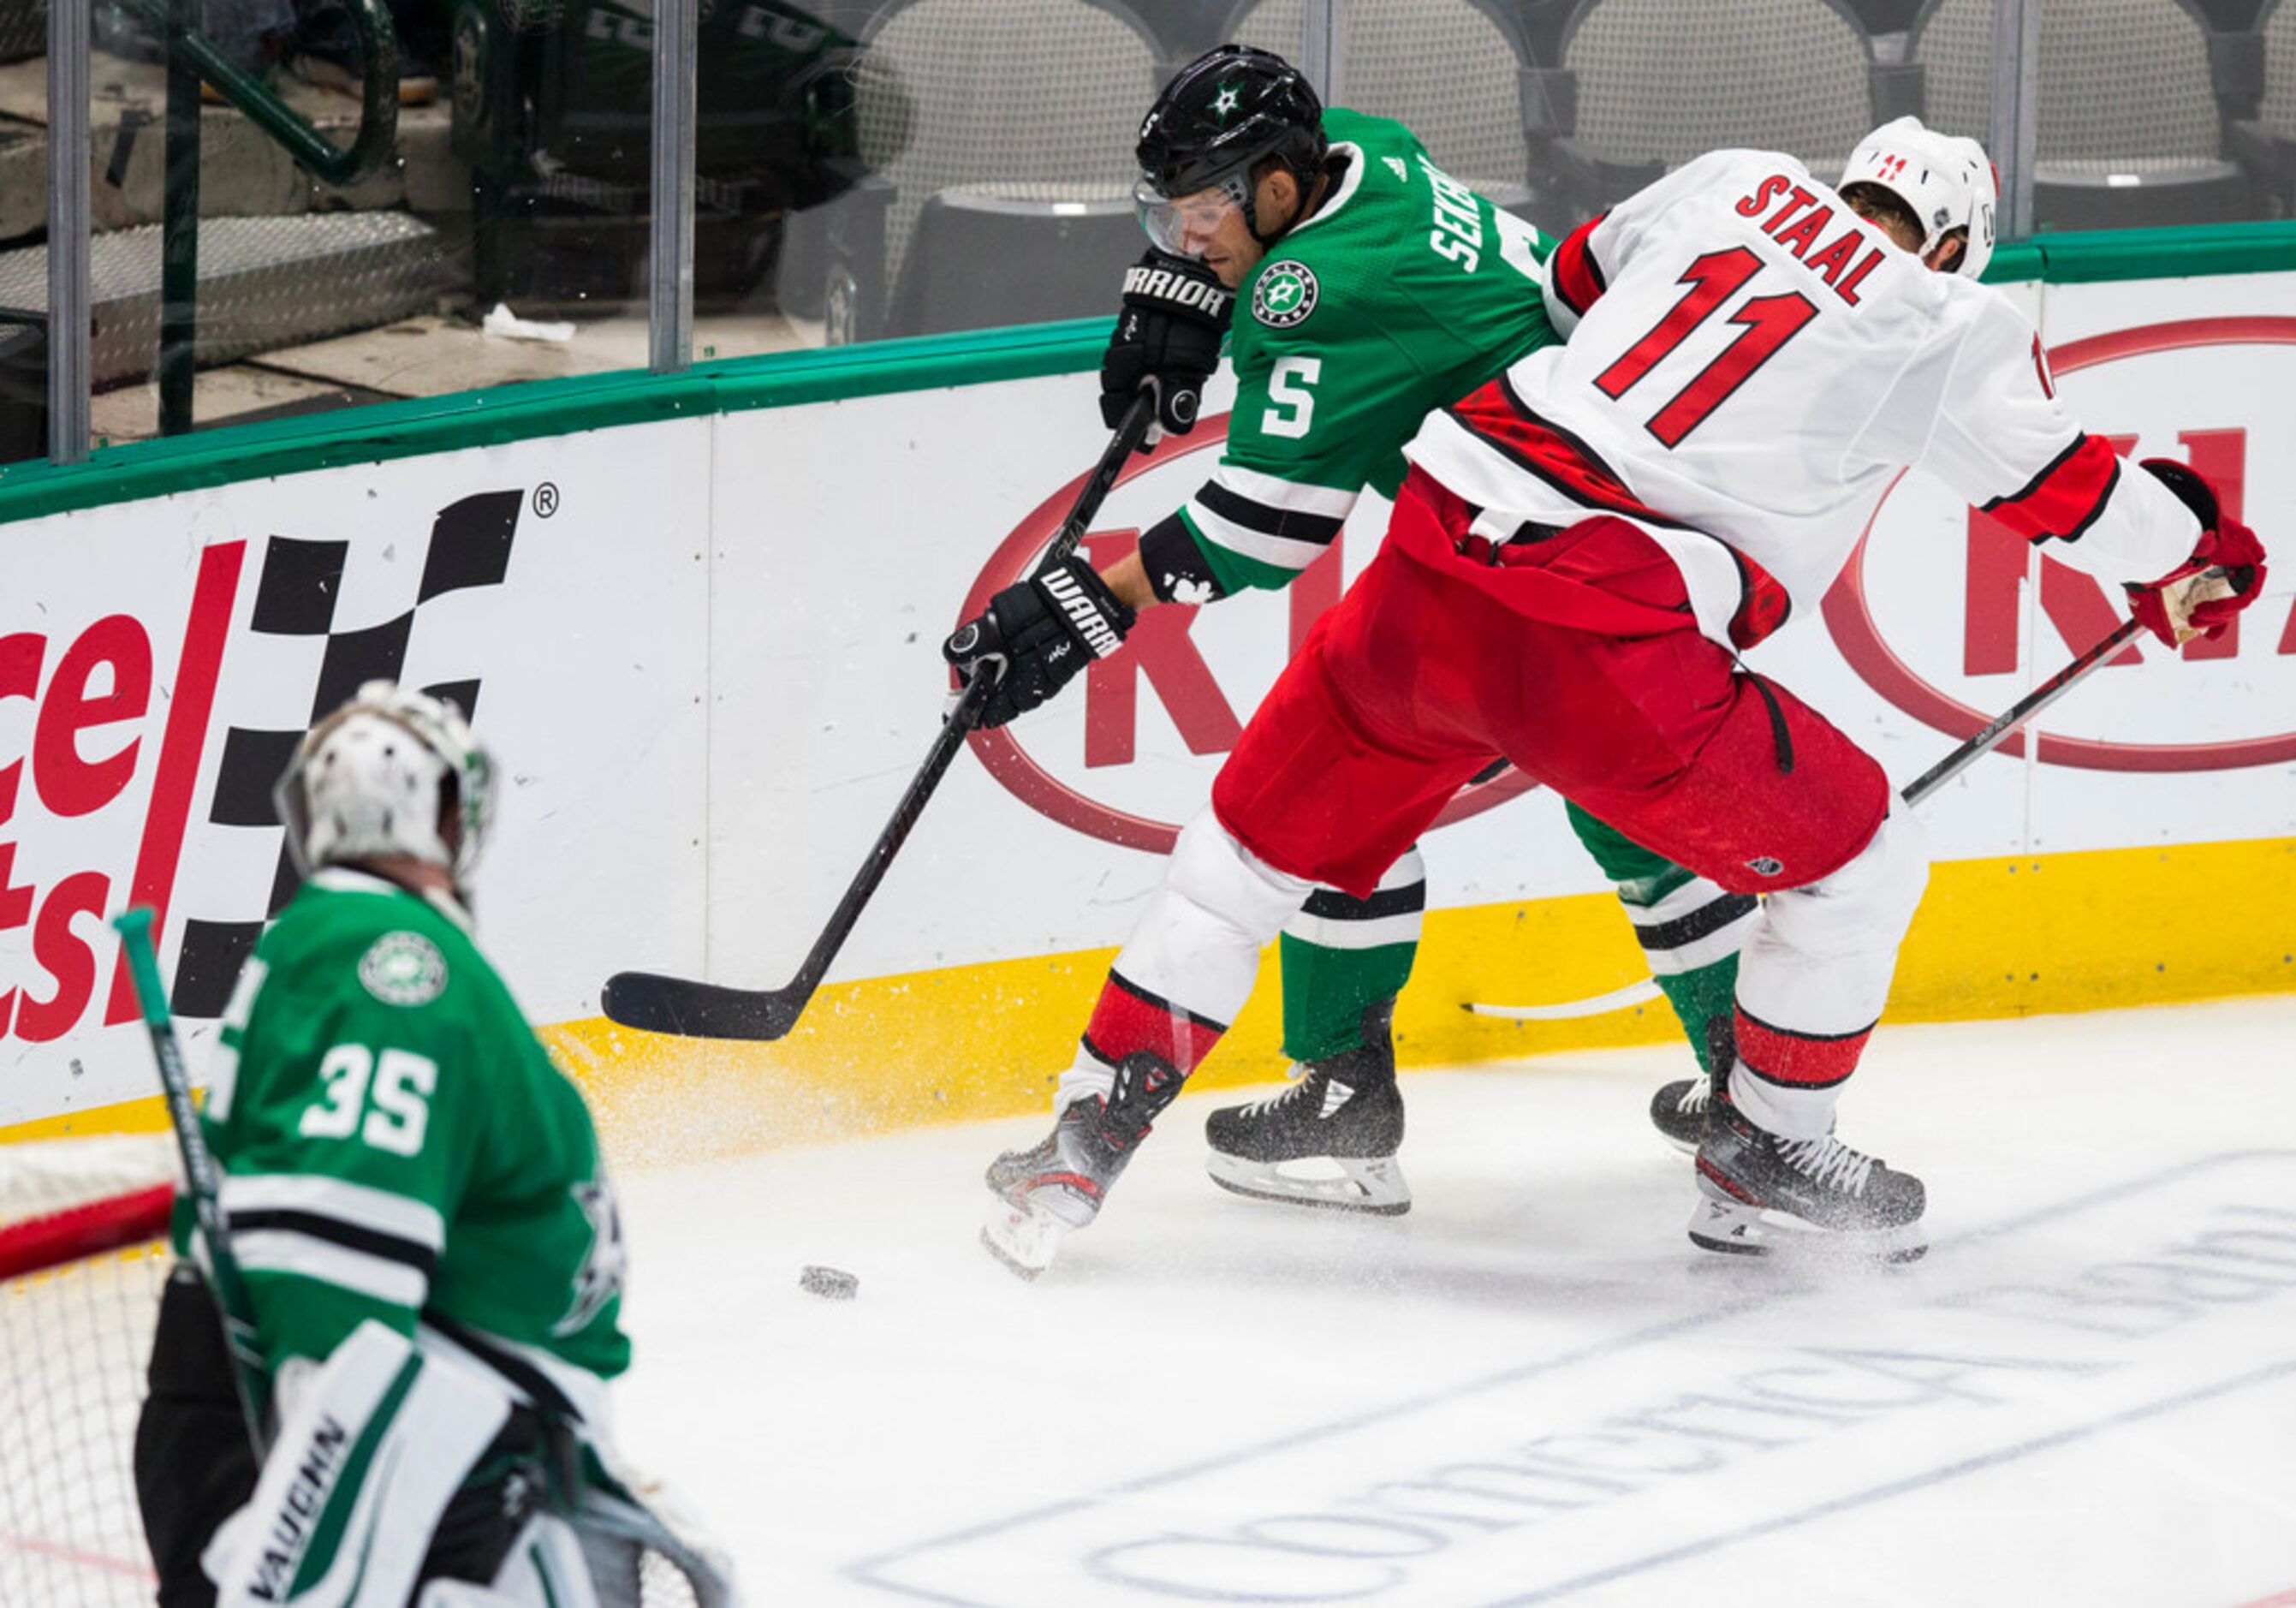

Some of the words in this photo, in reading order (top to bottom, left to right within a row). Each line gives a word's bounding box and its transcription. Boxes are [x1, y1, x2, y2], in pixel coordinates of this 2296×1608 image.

[1734, 174, 1886, 308] STAAL
[1261, 356, 1322, 439] 5
[1591, 245, 1821, 451] 11
[1964, 426, 2296, 677] KI
[297, 1042, 439, 1158] 35
